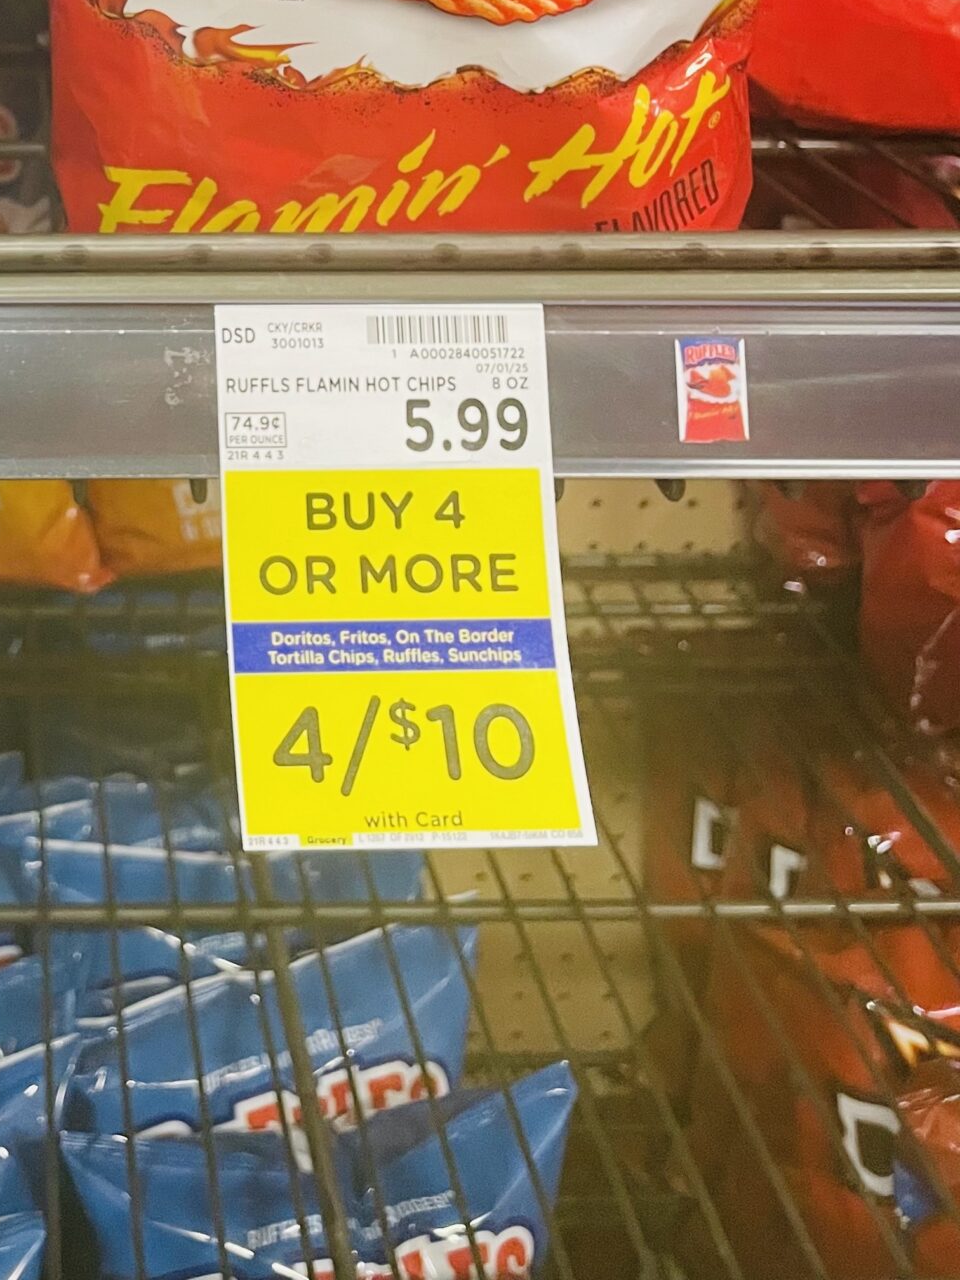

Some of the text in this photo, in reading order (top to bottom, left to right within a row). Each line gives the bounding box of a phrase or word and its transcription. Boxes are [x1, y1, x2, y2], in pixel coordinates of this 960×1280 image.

[524, 71, 730, 210] Hot
[594, 158, 719, 232] VORED
[221, 327, 256, 344] DSD
[267, 322, 323, 335] CKY/CRKR
[271, 338, 325, 349] 3001013
[410, 347, 525, 360] A0002840051722
[475, 363, 529, 374] 07/01/25
[226, 376, 529, 393] RUFFLS FLAMIN HOT CHIPS 8 OZ
[231, 416, 281, 431] 74.9¢
[405, 397, 528, 452] 5.99
[229, 434, 284, 445] PER OUNCE
[305, 490, 466, 531] BUY 4
[259, 553, 520, 596] OR MORE
[271, 628, 514, 647] Doritos, Fritos, On The Border
[267, 647, 521, 666] Tortilla Chips, Ruffles, Sunchips
[272, 695, 535, 796] 4/$10
[364, 810, 464, 828] with Card
